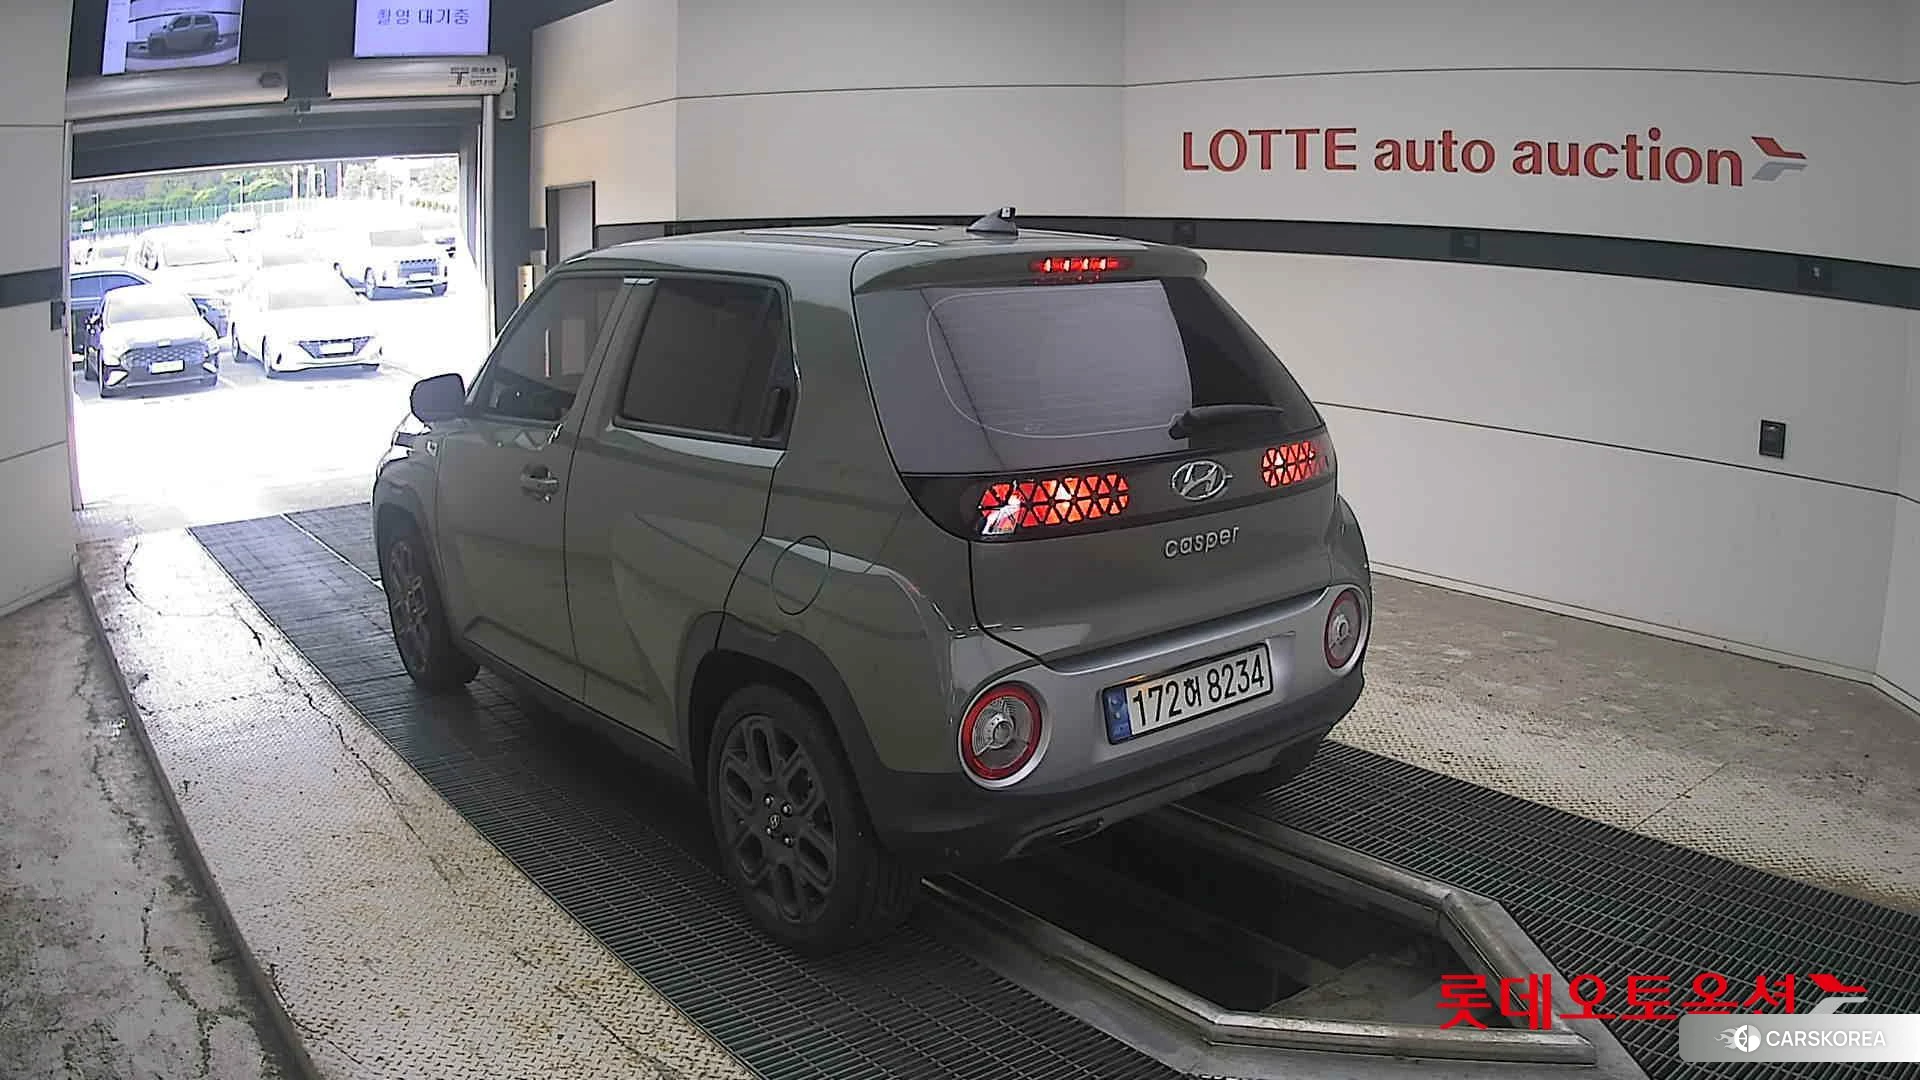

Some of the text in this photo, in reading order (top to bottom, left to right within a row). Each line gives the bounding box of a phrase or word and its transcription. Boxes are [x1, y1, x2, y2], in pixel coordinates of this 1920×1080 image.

[418, 8, 470, 25] 대기중
[1181, 126, 1744, 187] LOTTE auto auction
[1164, 525, 1240, 558] casper
[1131, 654, 1265, 727] 172허 8234
